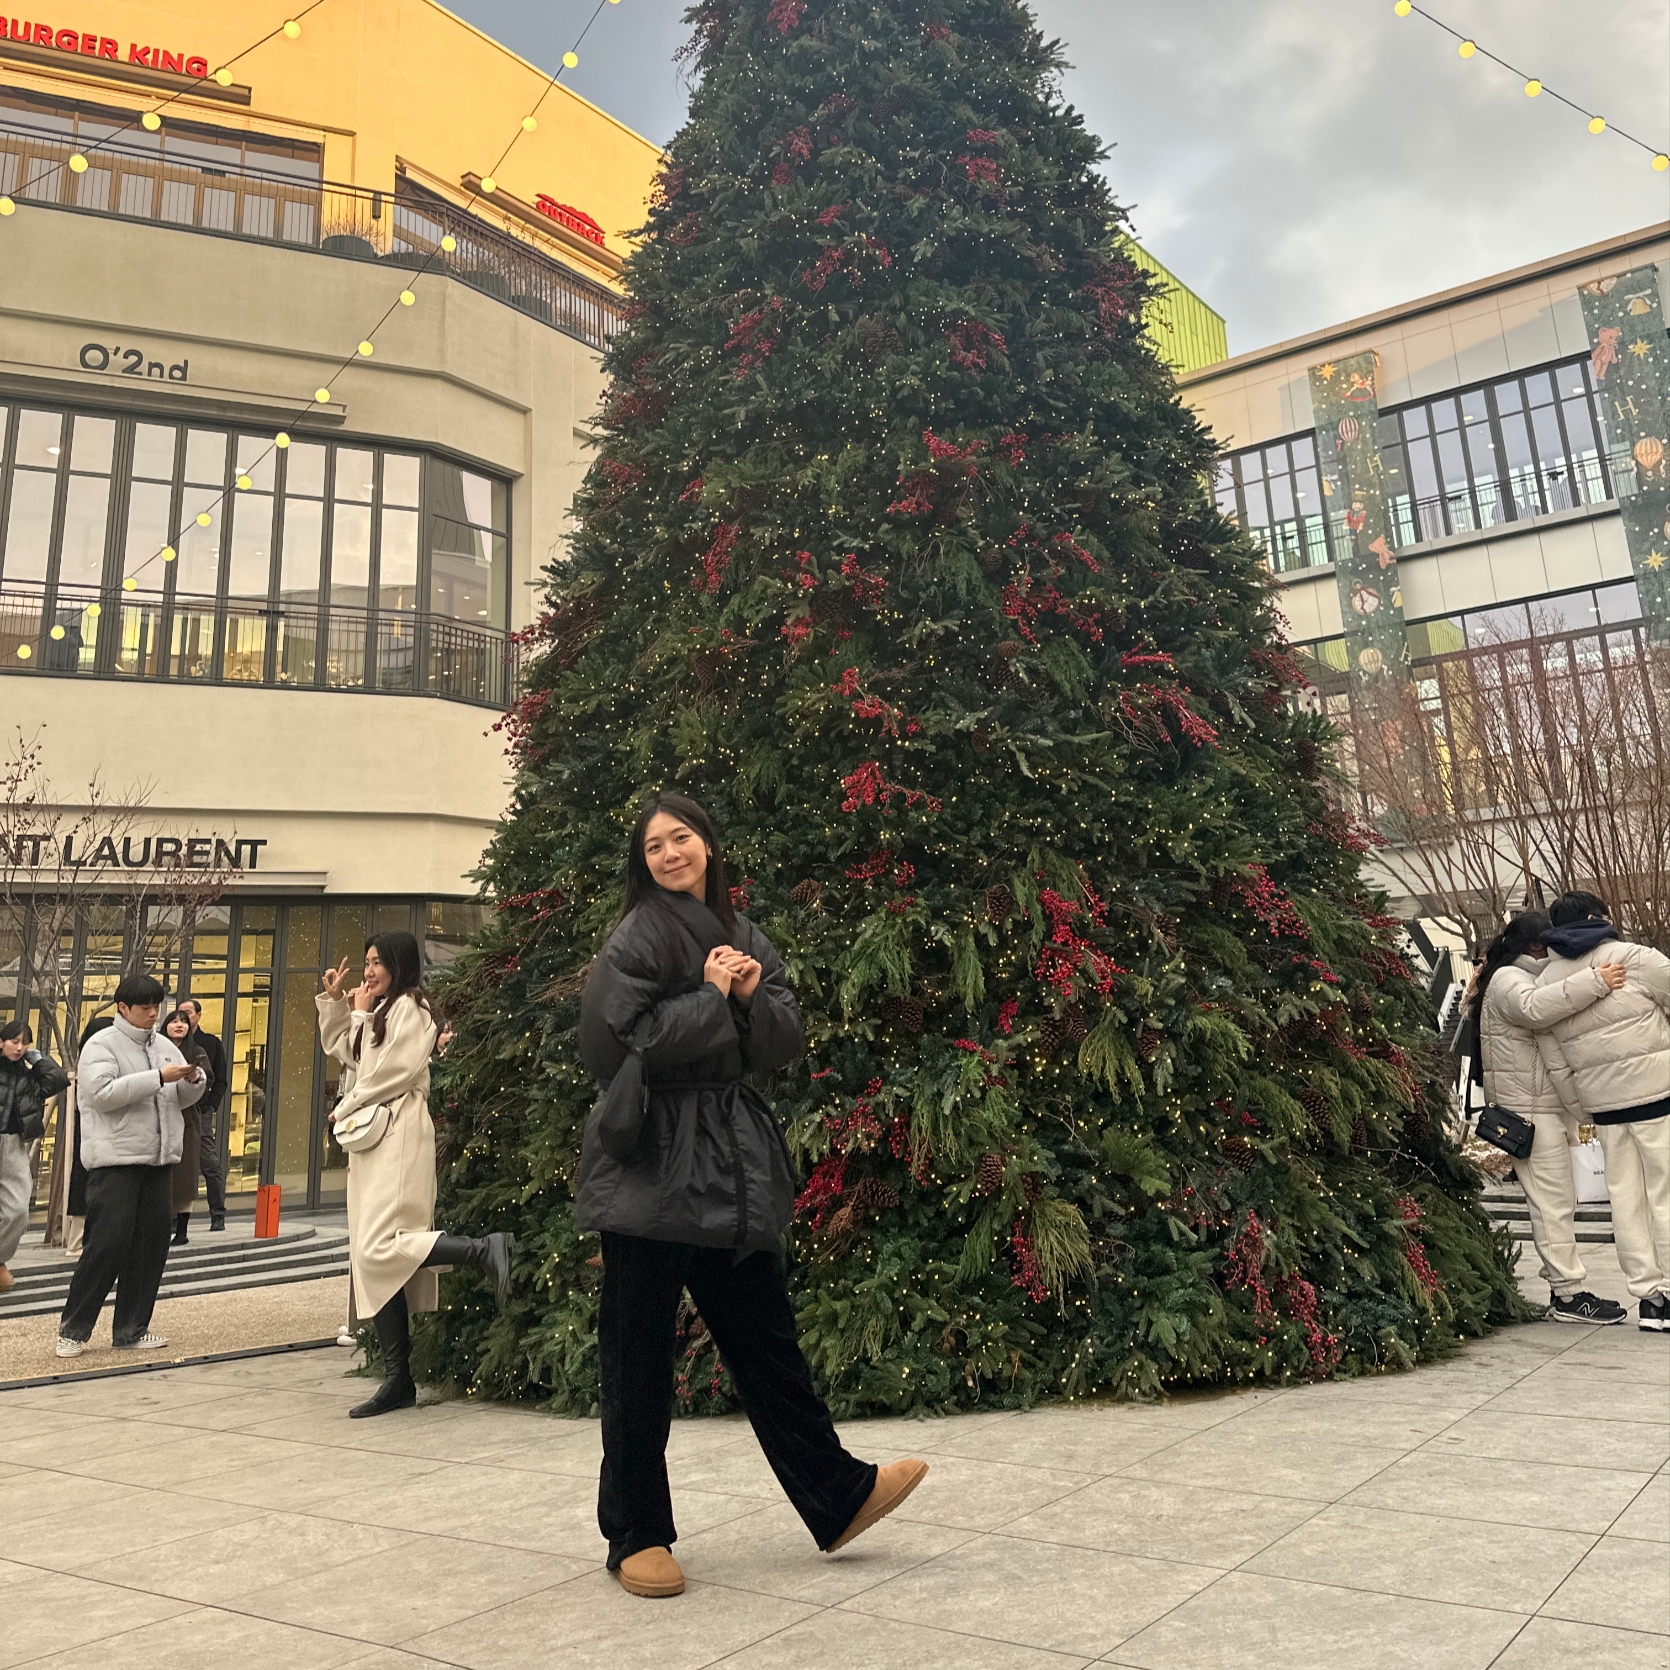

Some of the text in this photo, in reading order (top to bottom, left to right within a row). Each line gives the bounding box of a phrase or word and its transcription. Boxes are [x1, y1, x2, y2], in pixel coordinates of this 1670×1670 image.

[128, 43, 208, 77] KING
[535, 200, 605, 246] OUTBACK
[80, 343, 188, 382] O'2nd
[63, 835, 267, 869] LAURENT
